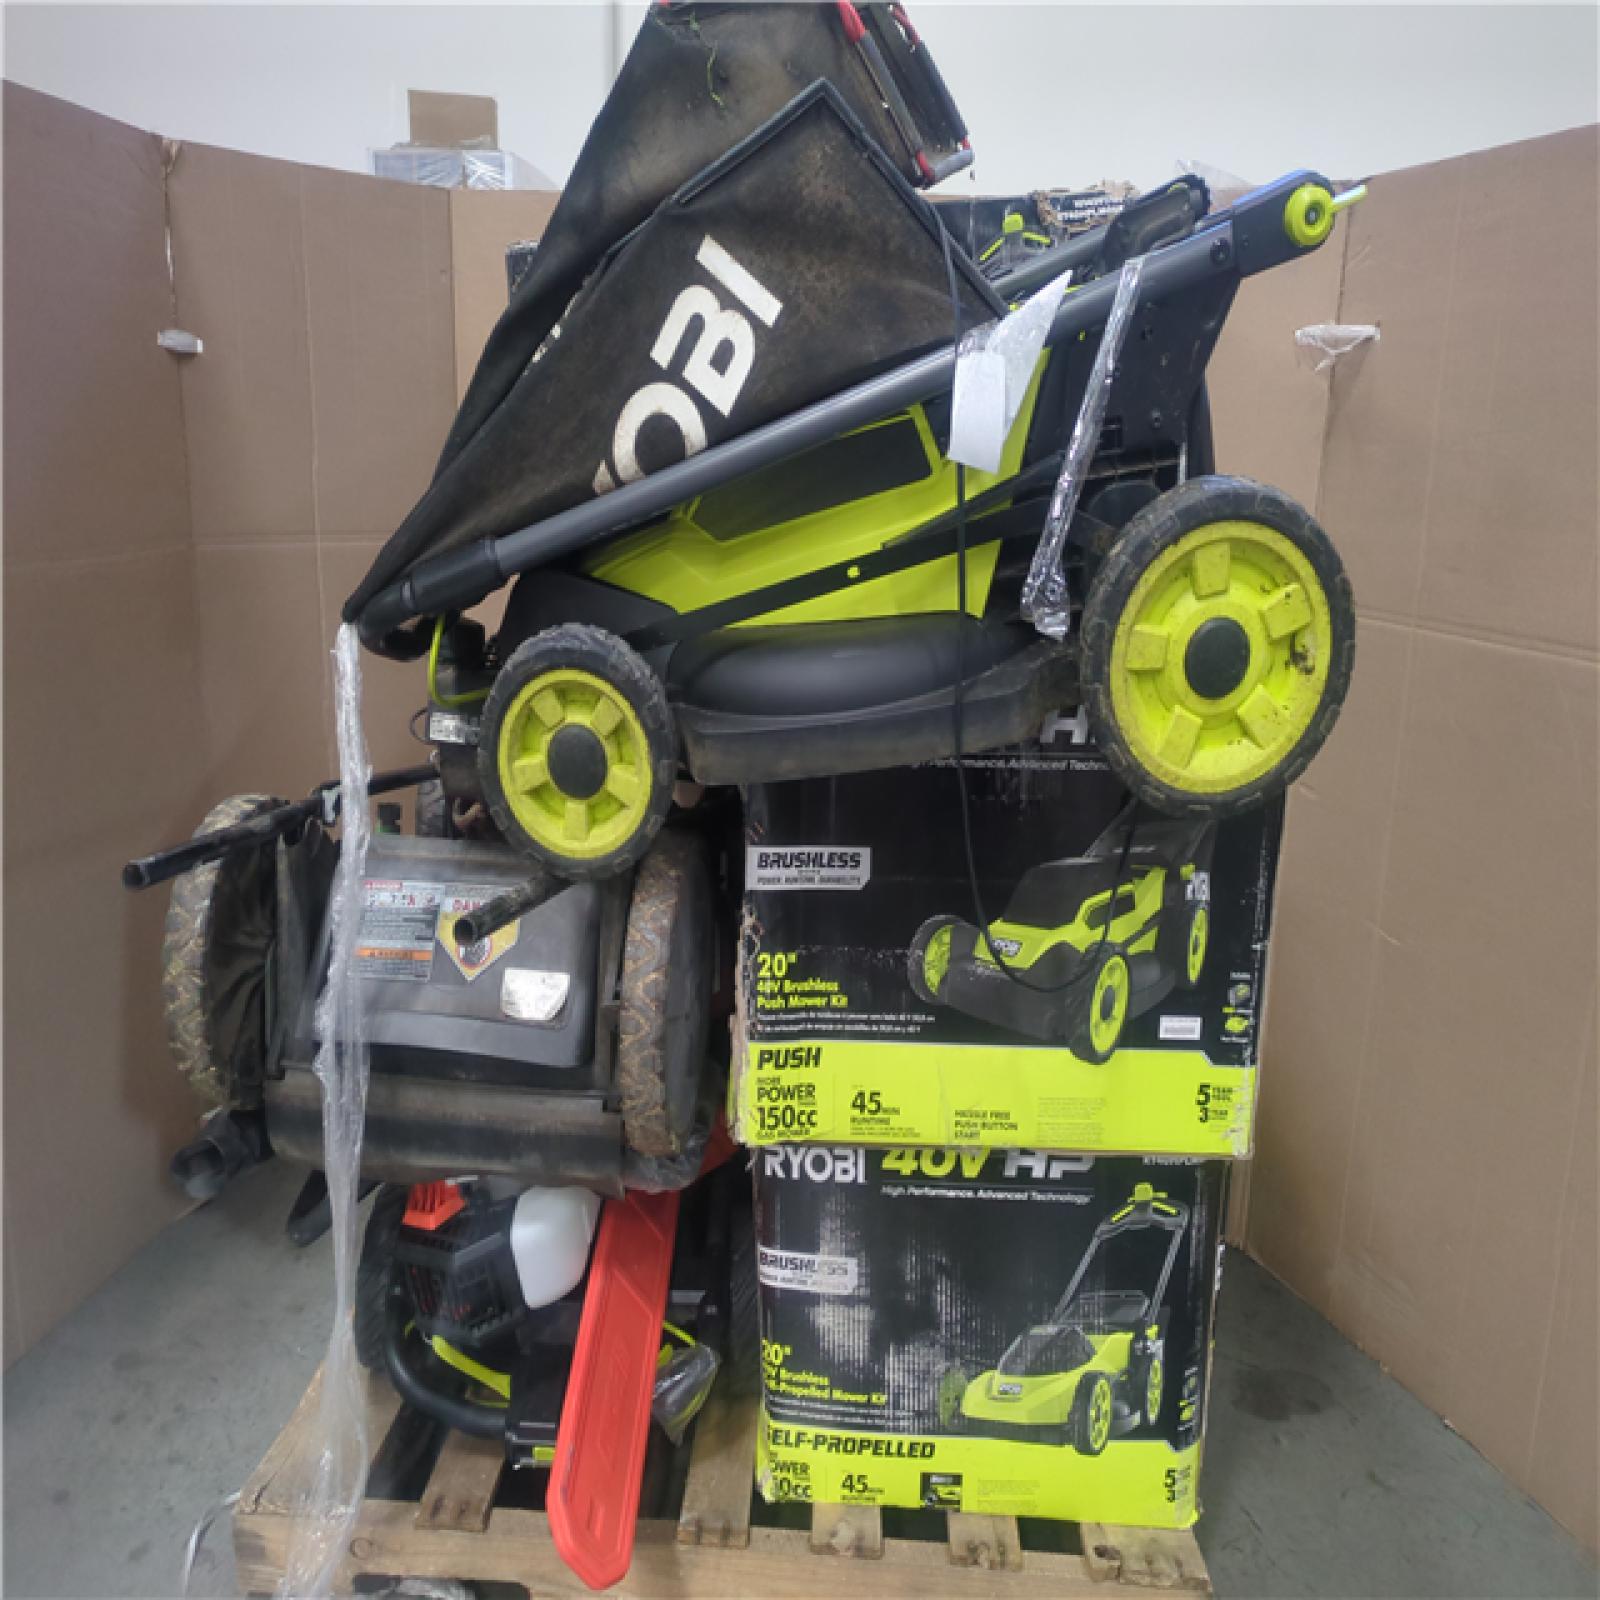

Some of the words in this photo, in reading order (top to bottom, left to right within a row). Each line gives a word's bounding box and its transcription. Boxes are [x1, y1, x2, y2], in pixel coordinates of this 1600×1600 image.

[593, 234, 783, 495] OBI
[757, 852, 861, 869] BRUSHLESS
[757, 953, 796, 977] 20"
[784, 978, 839, 992] Brushless
[757, 995, 785, 1008] Push
[788, 995, 828, 1008] Mower
[830, 995, 848, 1007] Kit
[757, 1047, 822, 1070] PUSH
[757, 1084, 815, 1102] POWER
[851, 1090, 881, 1115] 45
[1197, 1084, 1211, 1106] 5
[757, 1104, 818, 1131] 150cc
[1199, 1106, 1209, 1123] 3
[764, 1146, 866, 1184] RYOBI
[881, 1146, 990, 1179] 40V
[907, 1186, 974, 1197] Performance
[977, 1189, 1028, 1200] Advanced
[760, 1253, 848, 1275] BRUSHLSS
[770, 1460, 811, 1477] OWER
[1165, 1468, 1175, 1488] 5
[841, 1473, 868, 1493] 45
